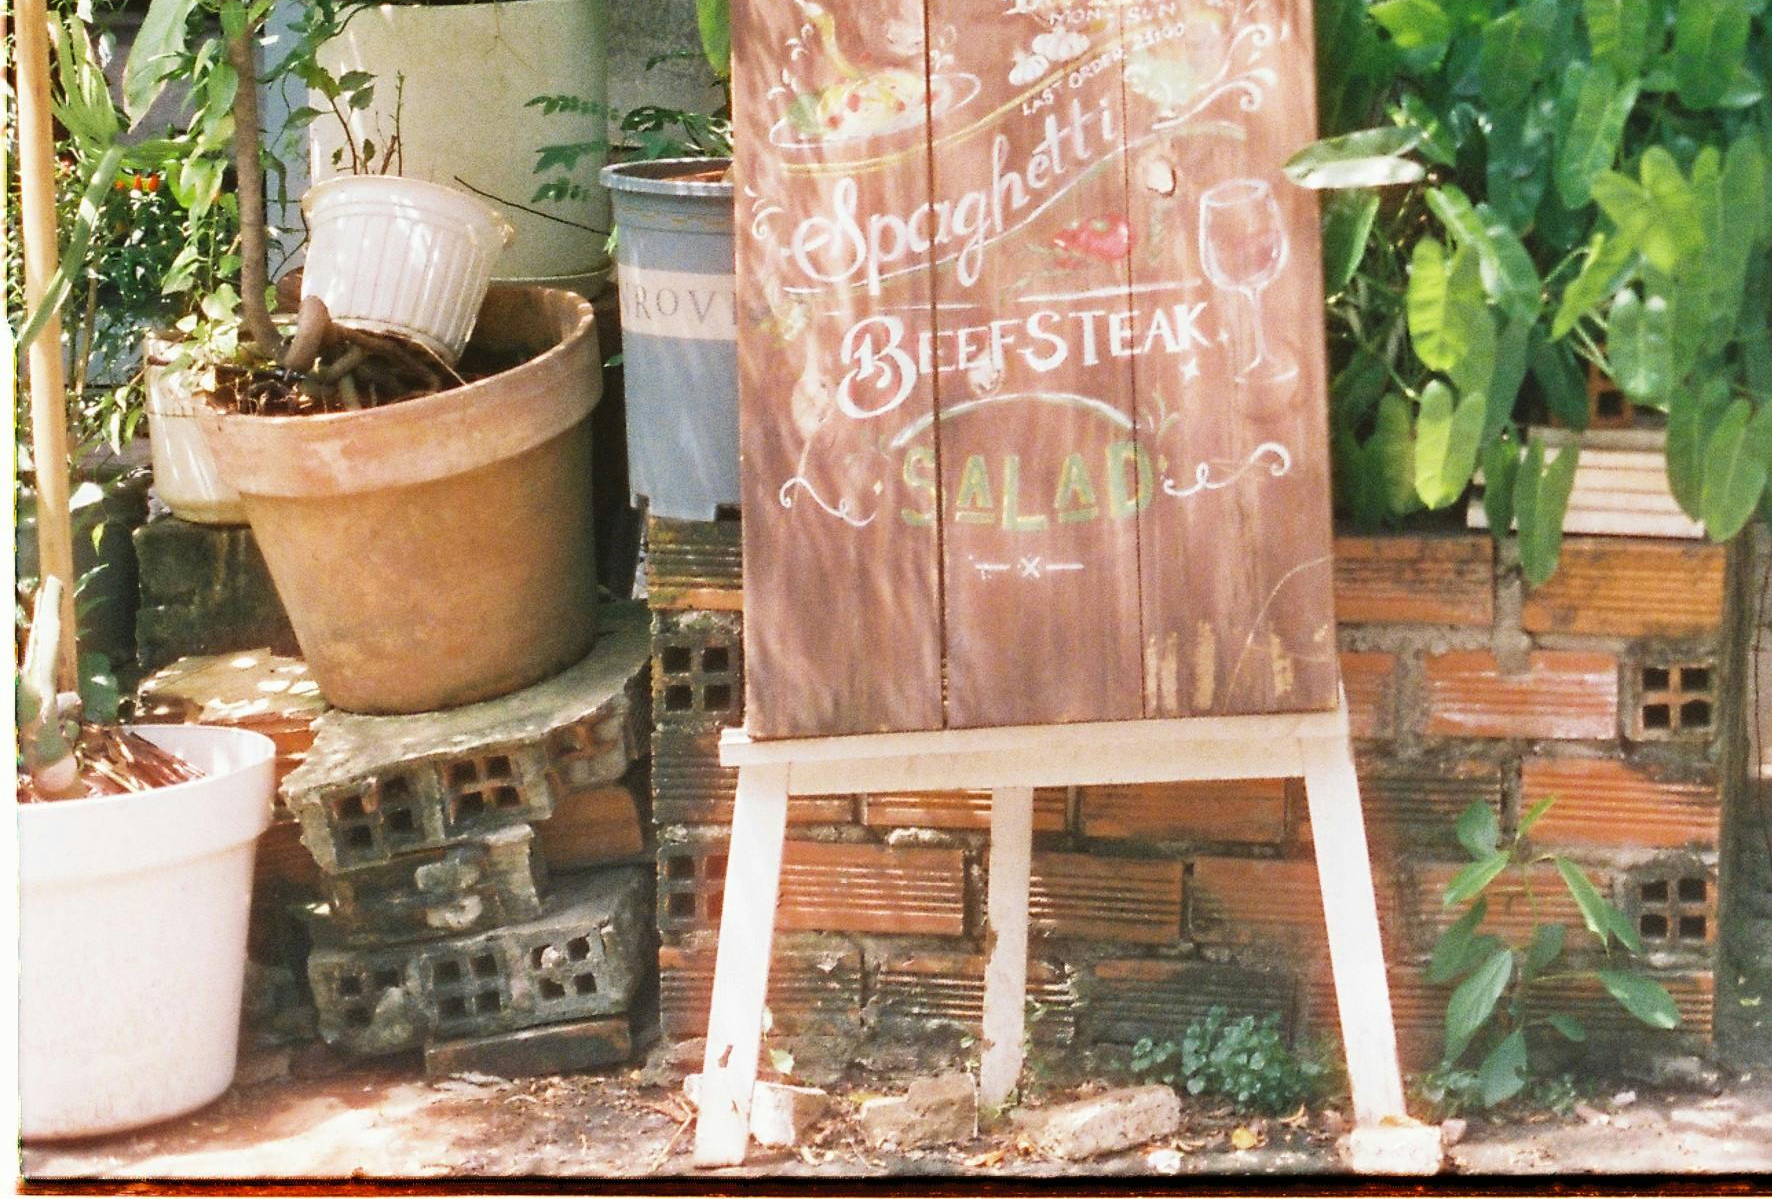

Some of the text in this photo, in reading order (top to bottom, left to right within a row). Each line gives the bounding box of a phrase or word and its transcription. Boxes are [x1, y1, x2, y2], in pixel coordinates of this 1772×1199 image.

[1022, 81, 1062, 116] LAST
[791, 98, 1119, 296] Spaghetti
[900, 440, 1154, 533] SALAD
